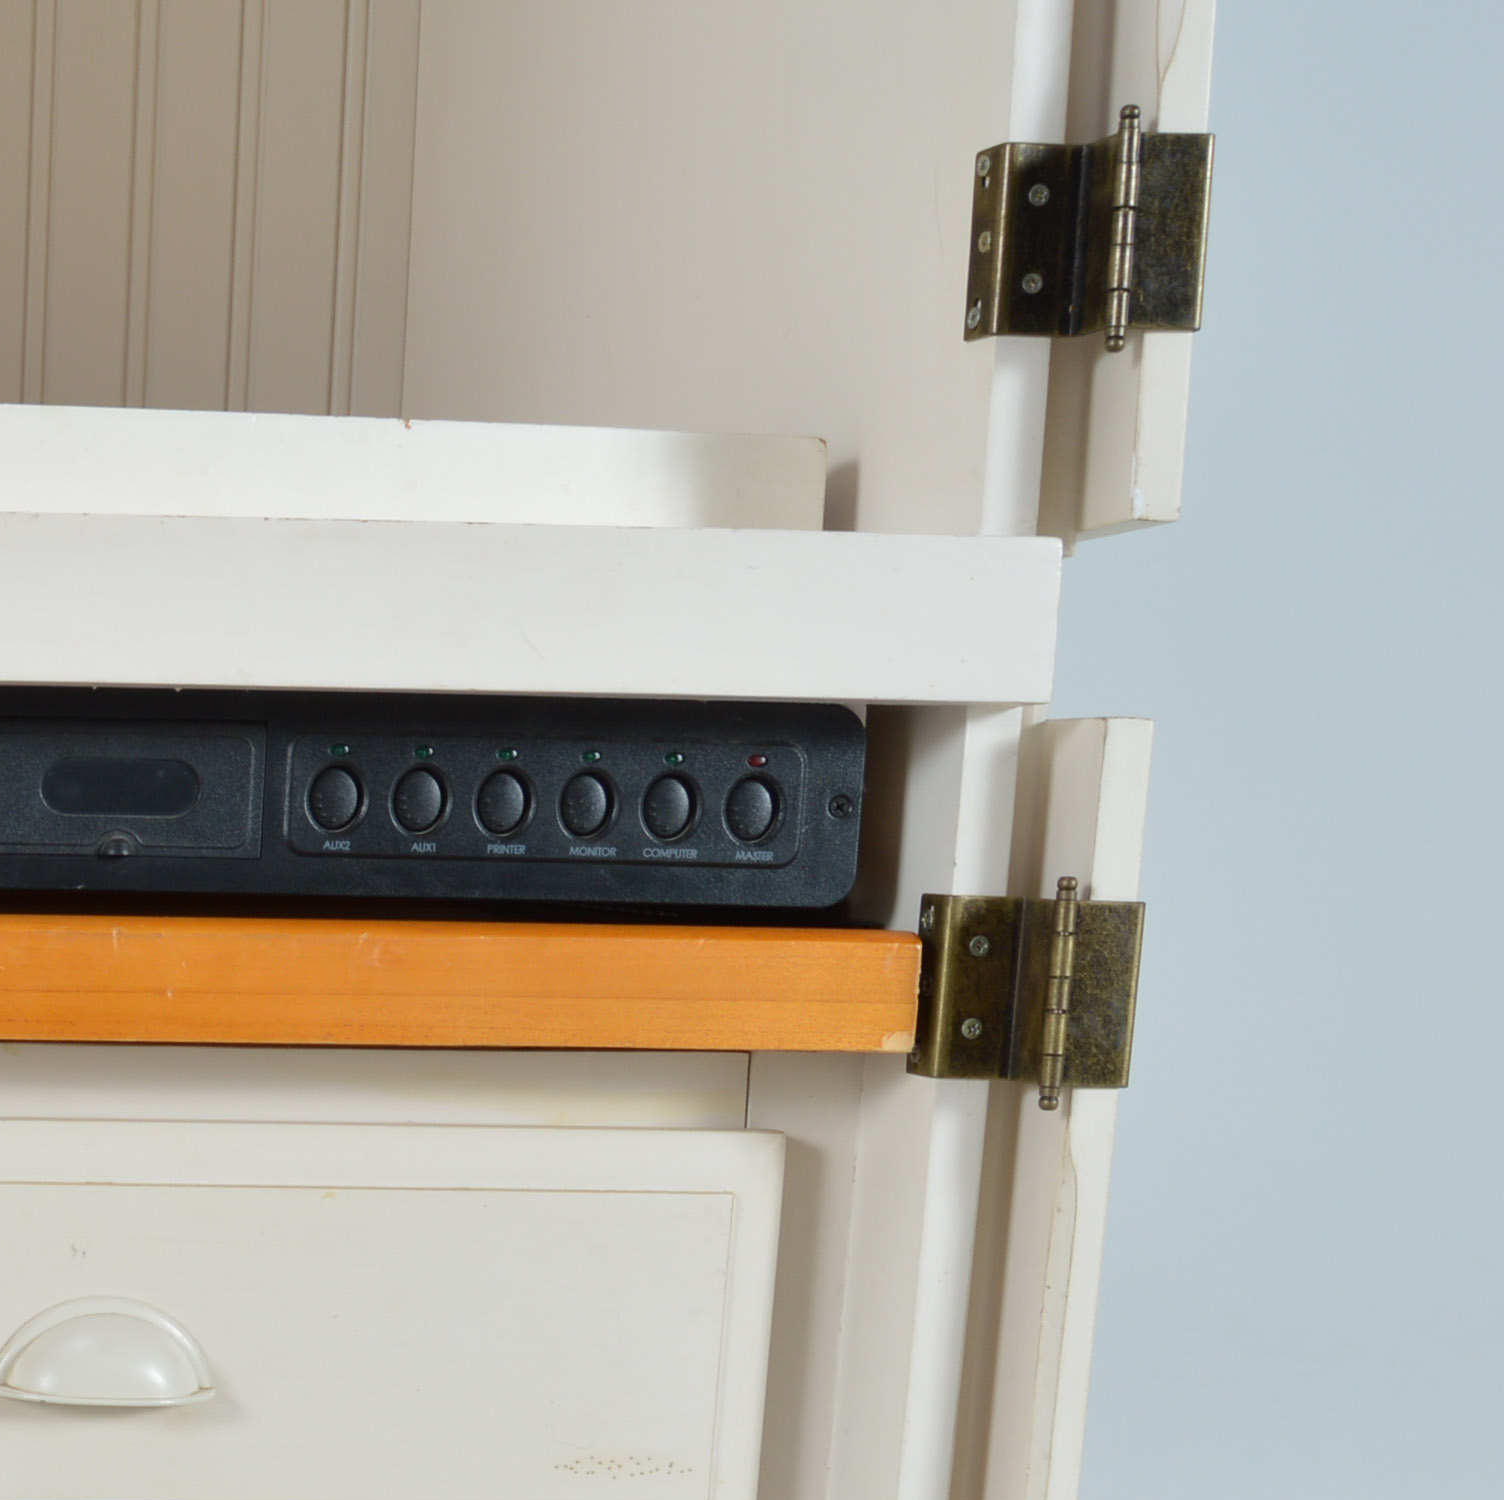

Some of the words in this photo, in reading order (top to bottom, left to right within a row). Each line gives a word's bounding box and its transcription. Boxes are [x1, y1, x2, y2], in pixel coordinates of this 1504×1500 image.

[323, 840, 352, 851] AUX2
[411, 842, 437, 853] AUX1
[487, 844, 526, 855] PRINTER
[569, 846, 617, 857] MONITOR
[643, 847, 698, 859] COMPUTER
[735, 850, 774, 862] MASTER
